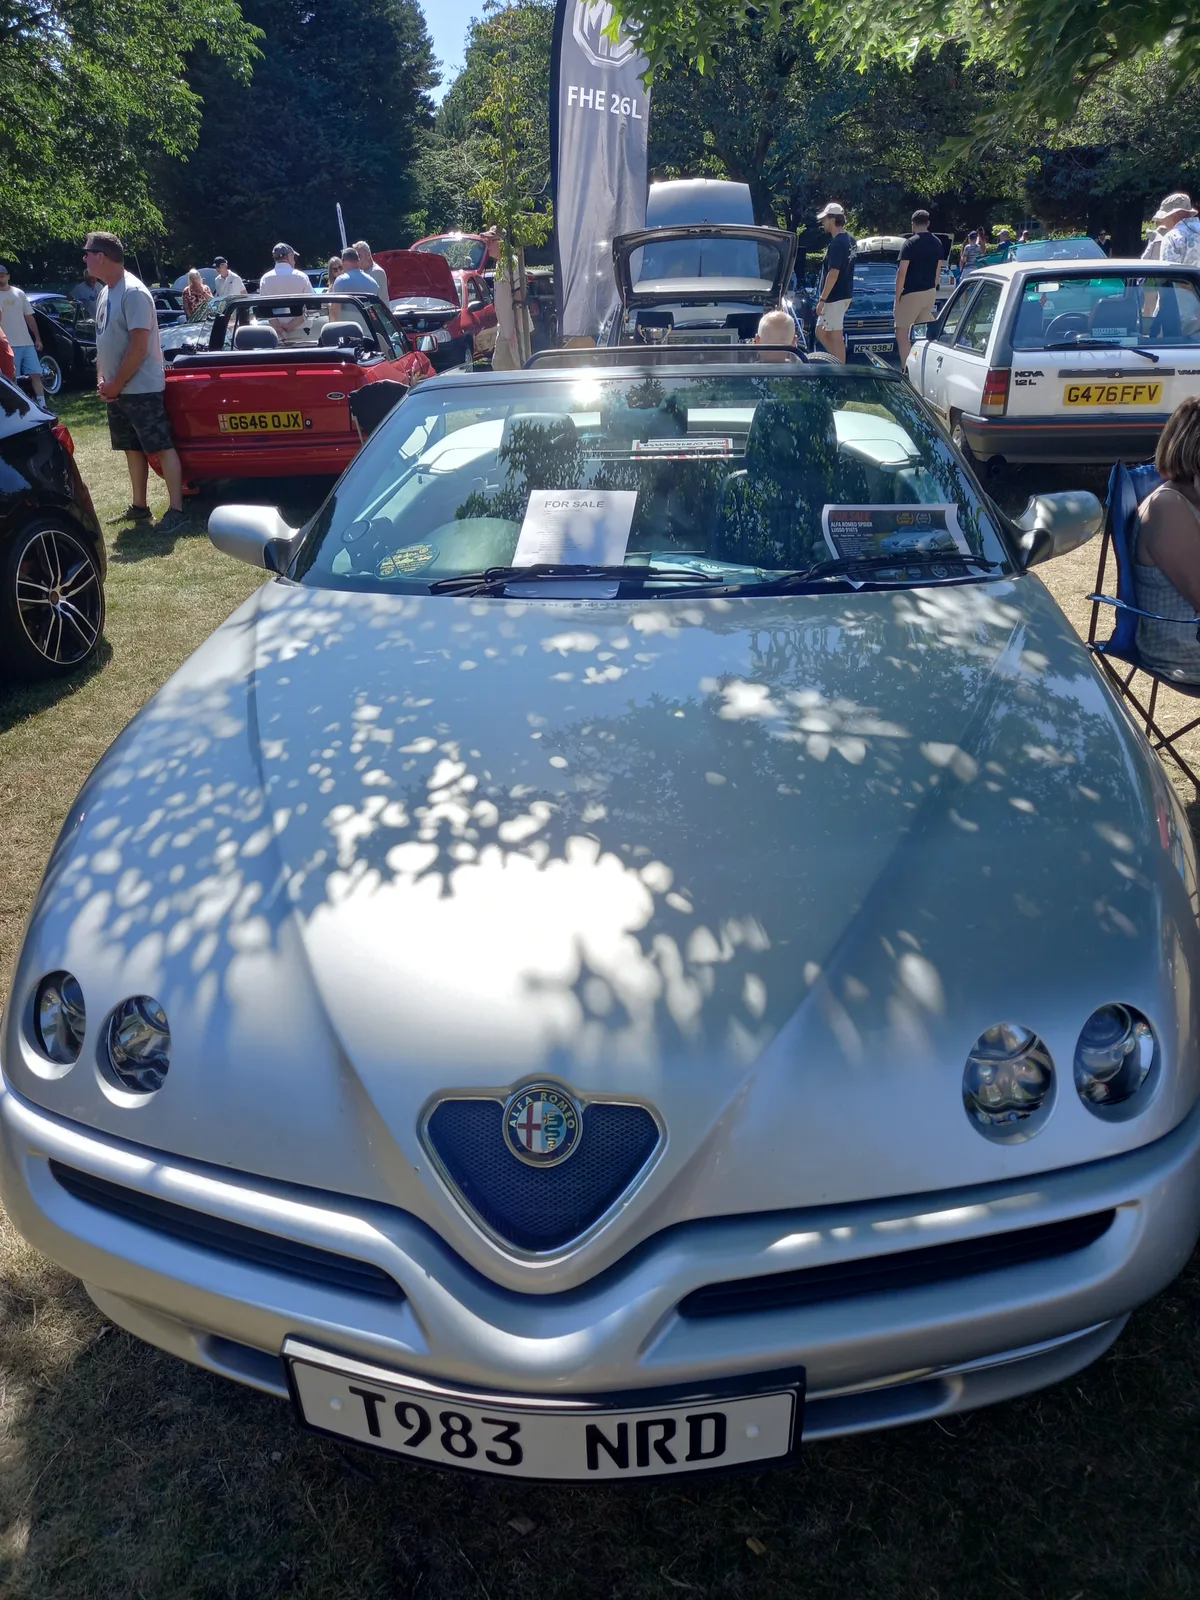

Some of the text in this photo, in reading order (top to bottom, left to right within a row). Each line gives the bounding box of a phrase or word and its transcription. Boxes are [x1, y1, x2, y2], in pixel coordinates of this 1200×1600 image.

[567, 85, 642, 119] FHE 26L
[872, 344, 892, 352] 938J
[1014, 370, 1044, 378] NOVA
[229, 414, 300, 429] G646 OJX
[849, 511, 871, 522] SALE
[509, 1091, 576, 1129] ALFA ROMEO
[348, 1385, 727, 1471] T983 NRD
